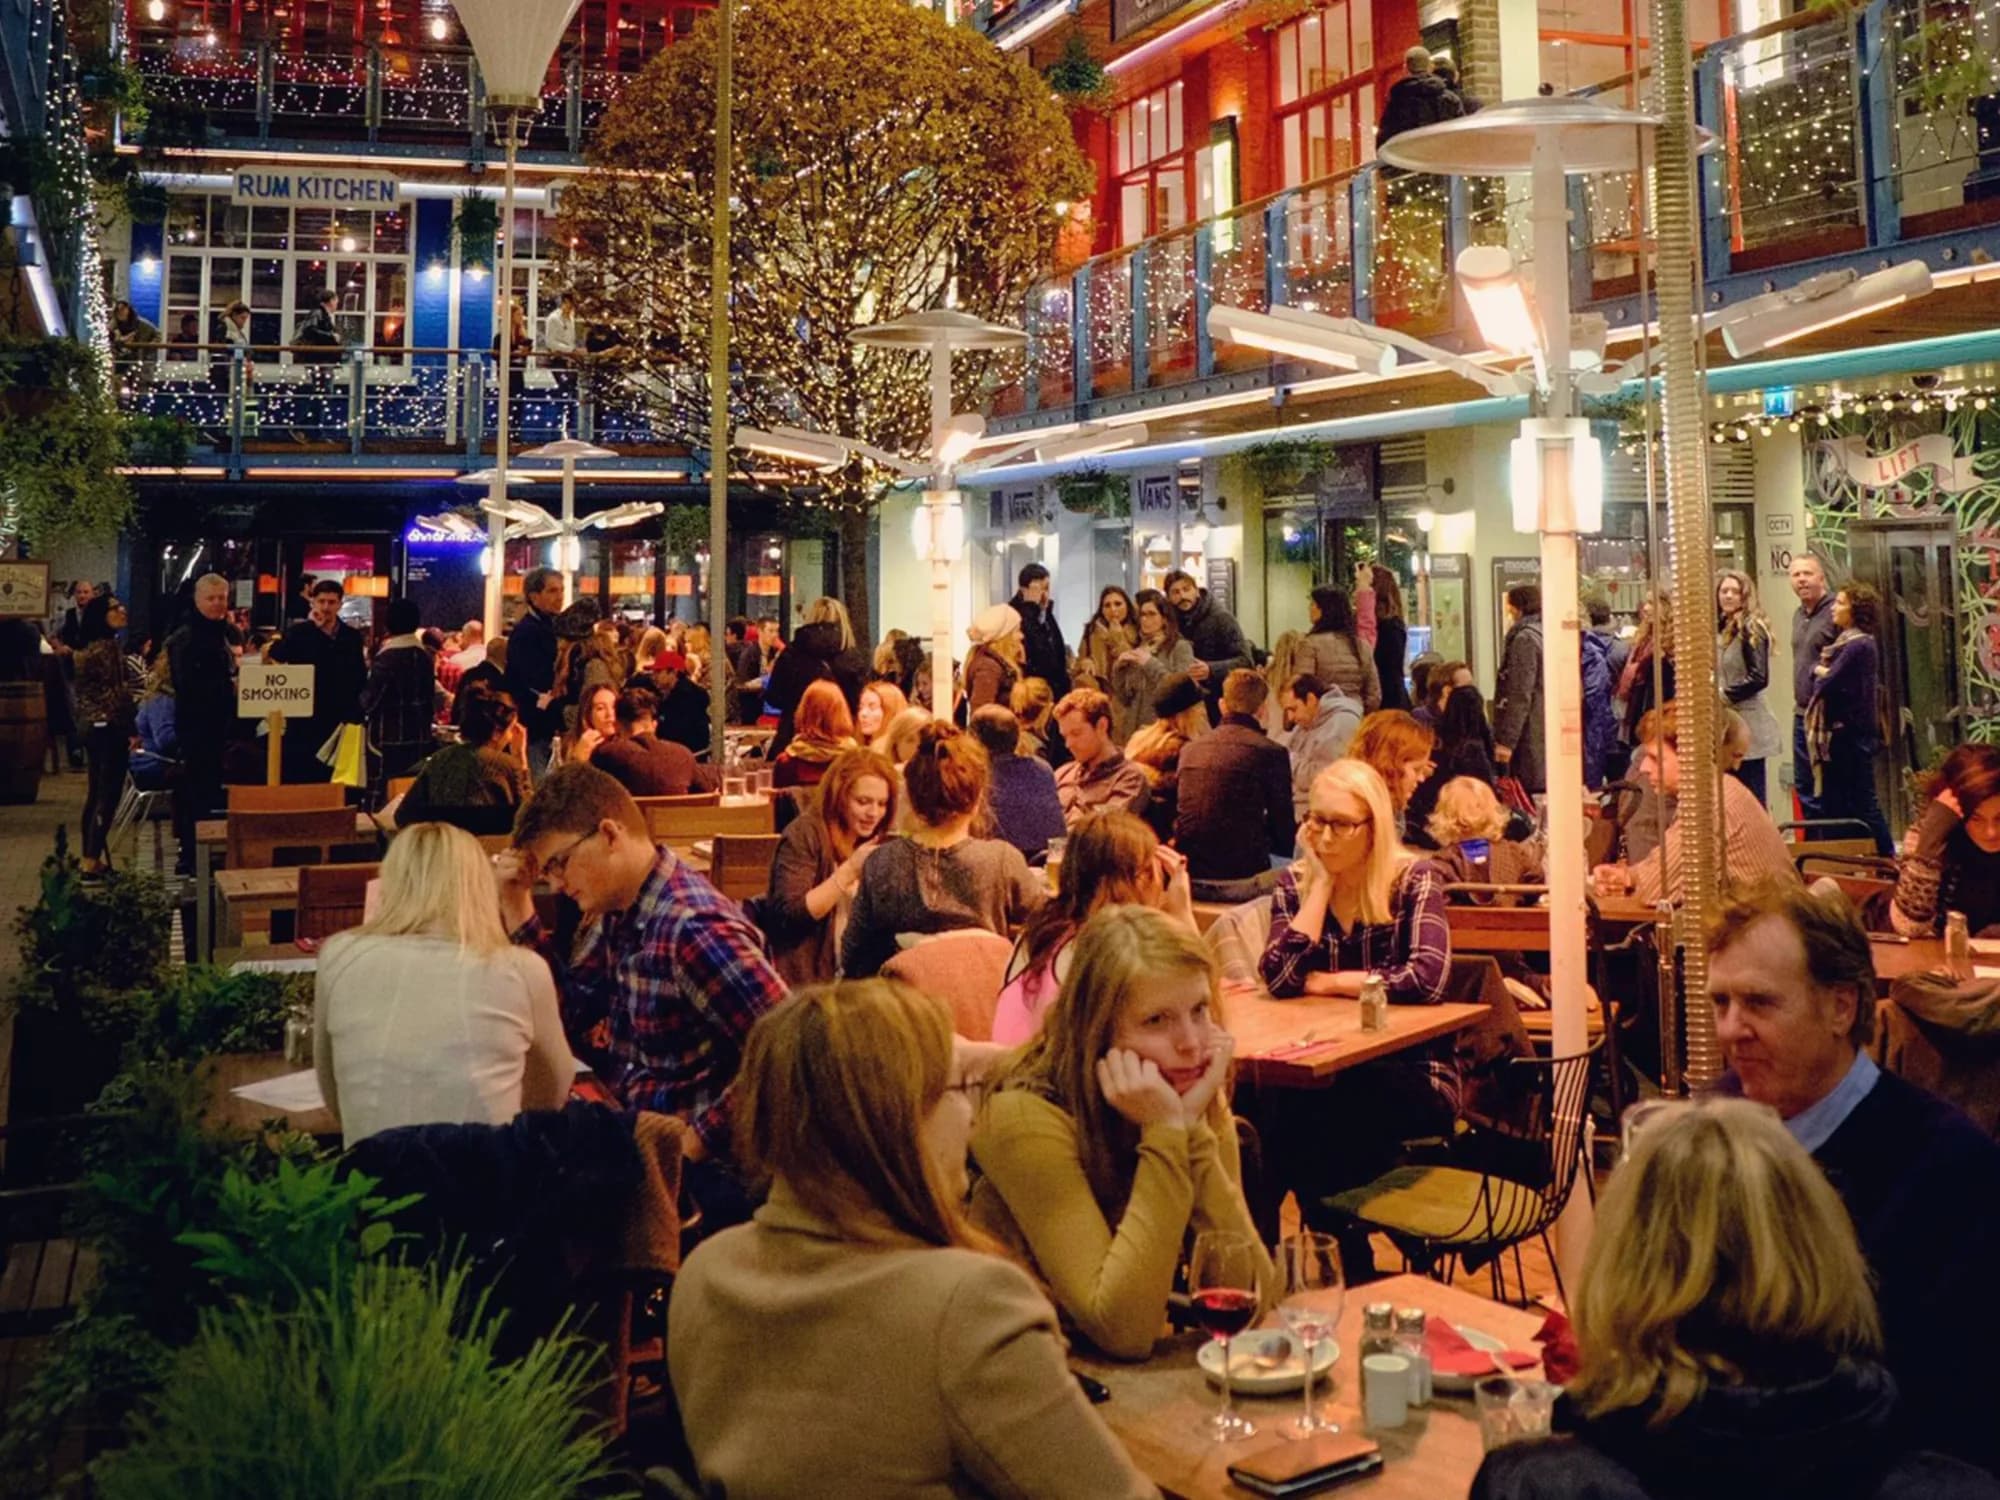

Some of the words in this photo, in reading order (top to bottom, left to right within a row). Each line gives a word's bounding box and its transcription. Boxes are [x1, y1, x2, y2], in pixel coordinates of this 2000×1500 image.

[238, 174, 290, 198] RUM
[297, 176, 395, 202] KITCHEN
[1878, 443, 1921, 481] LIFT
[1137, 476, 1172, 511] VANS
[1770, 550, 1793, 570] NO
[265, 673, 288, 687] NO
[241, 687, 311, 701] SMOKING
